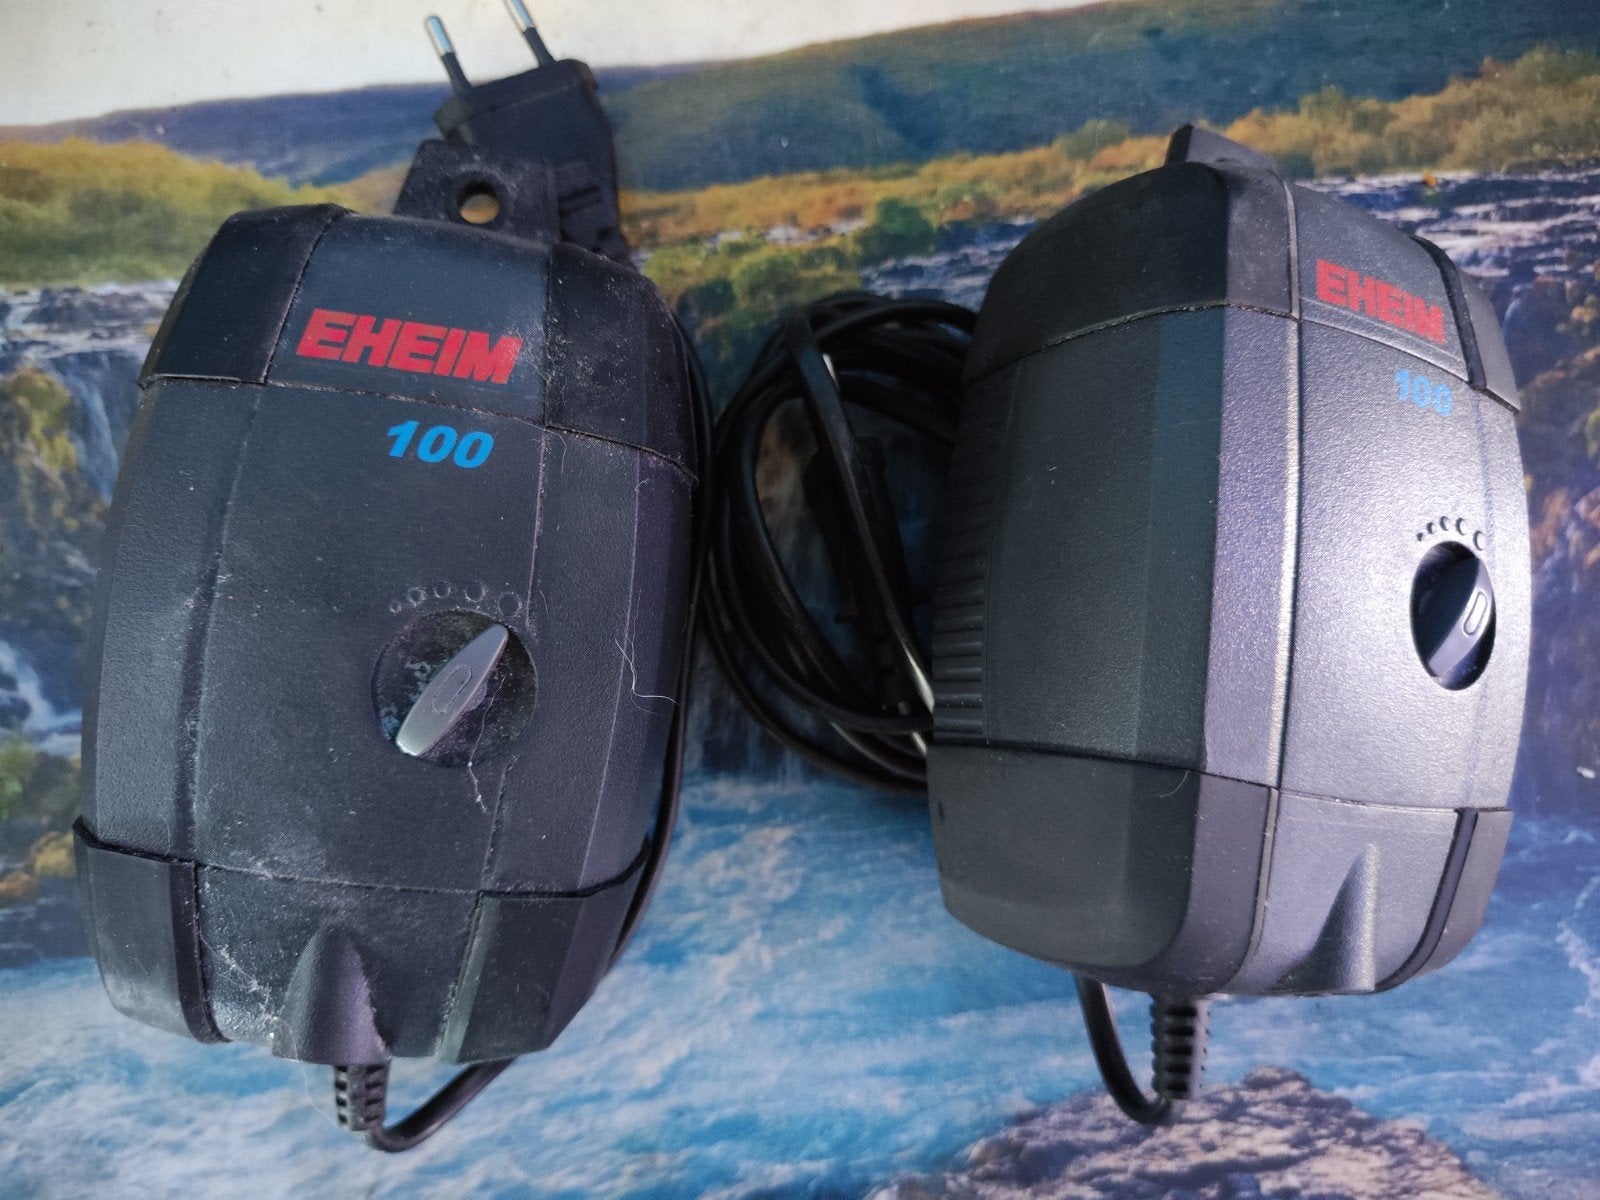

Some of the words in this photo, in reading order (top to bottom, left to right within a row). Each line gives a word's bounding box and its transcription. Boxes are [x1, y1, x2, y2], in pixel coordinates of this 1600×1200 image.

[1316, 258, 1446, 344] EHEIM
[296, 308, 524, 384] EHEIM
[1394, 368, 1454, 417] 100
[386, 419, 495, 469] 100
